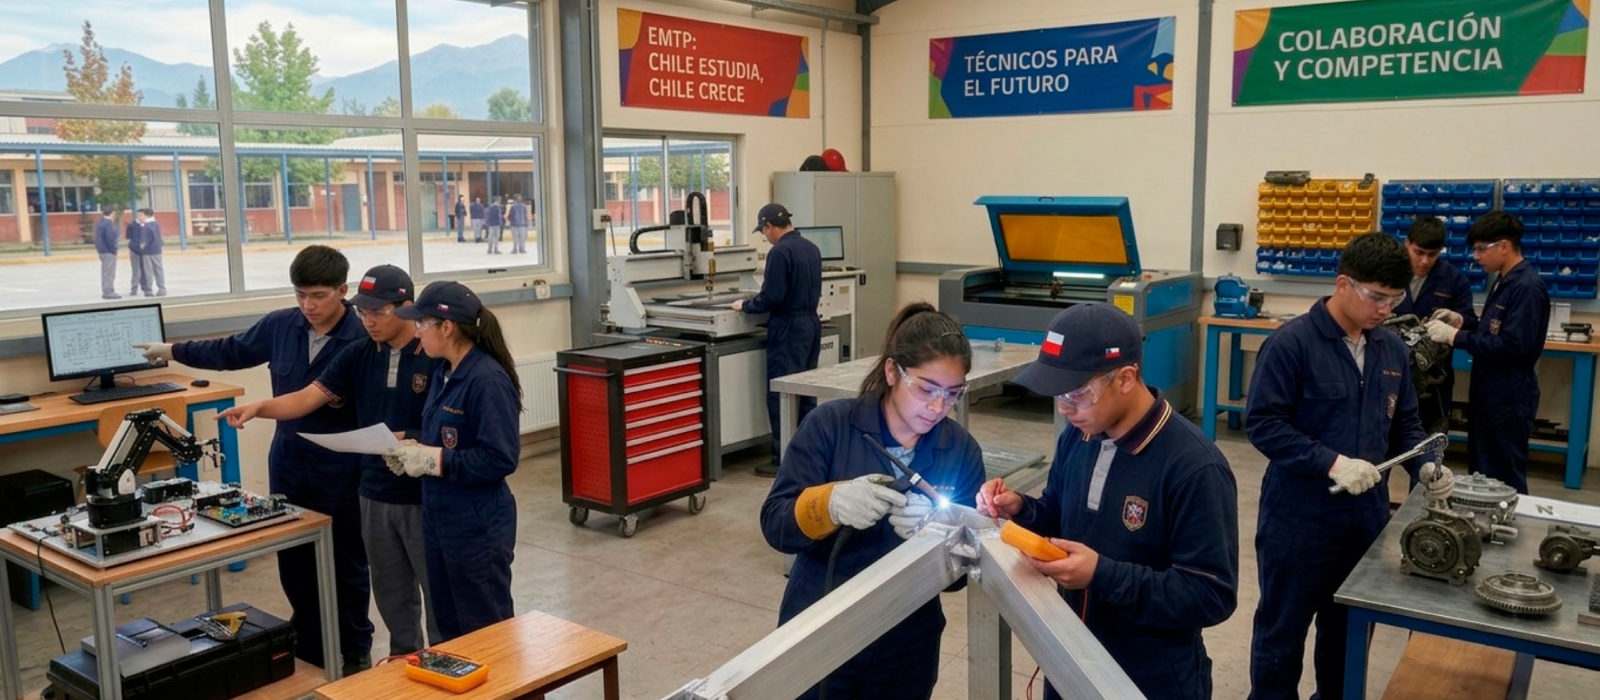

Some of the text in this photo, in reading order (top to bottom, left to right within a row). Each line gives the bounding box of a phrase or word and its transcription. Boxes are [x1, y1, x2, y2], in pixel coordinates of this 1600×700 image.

[648, 26, 696, 50] EMTP:
[1278, 12, 1501, 53] COLABORACIÓN
[649, 52, 763, 84] CHILE ESTUDIA,
[964, 45, 1118, 73] TÉCNICOS PARA
[1274, 47, 1503, 81] Y COMPETENCIA
[649, 78, 744, 102] CHILE CRECE
[964, 74, 1069, 96] EL FUTURO
